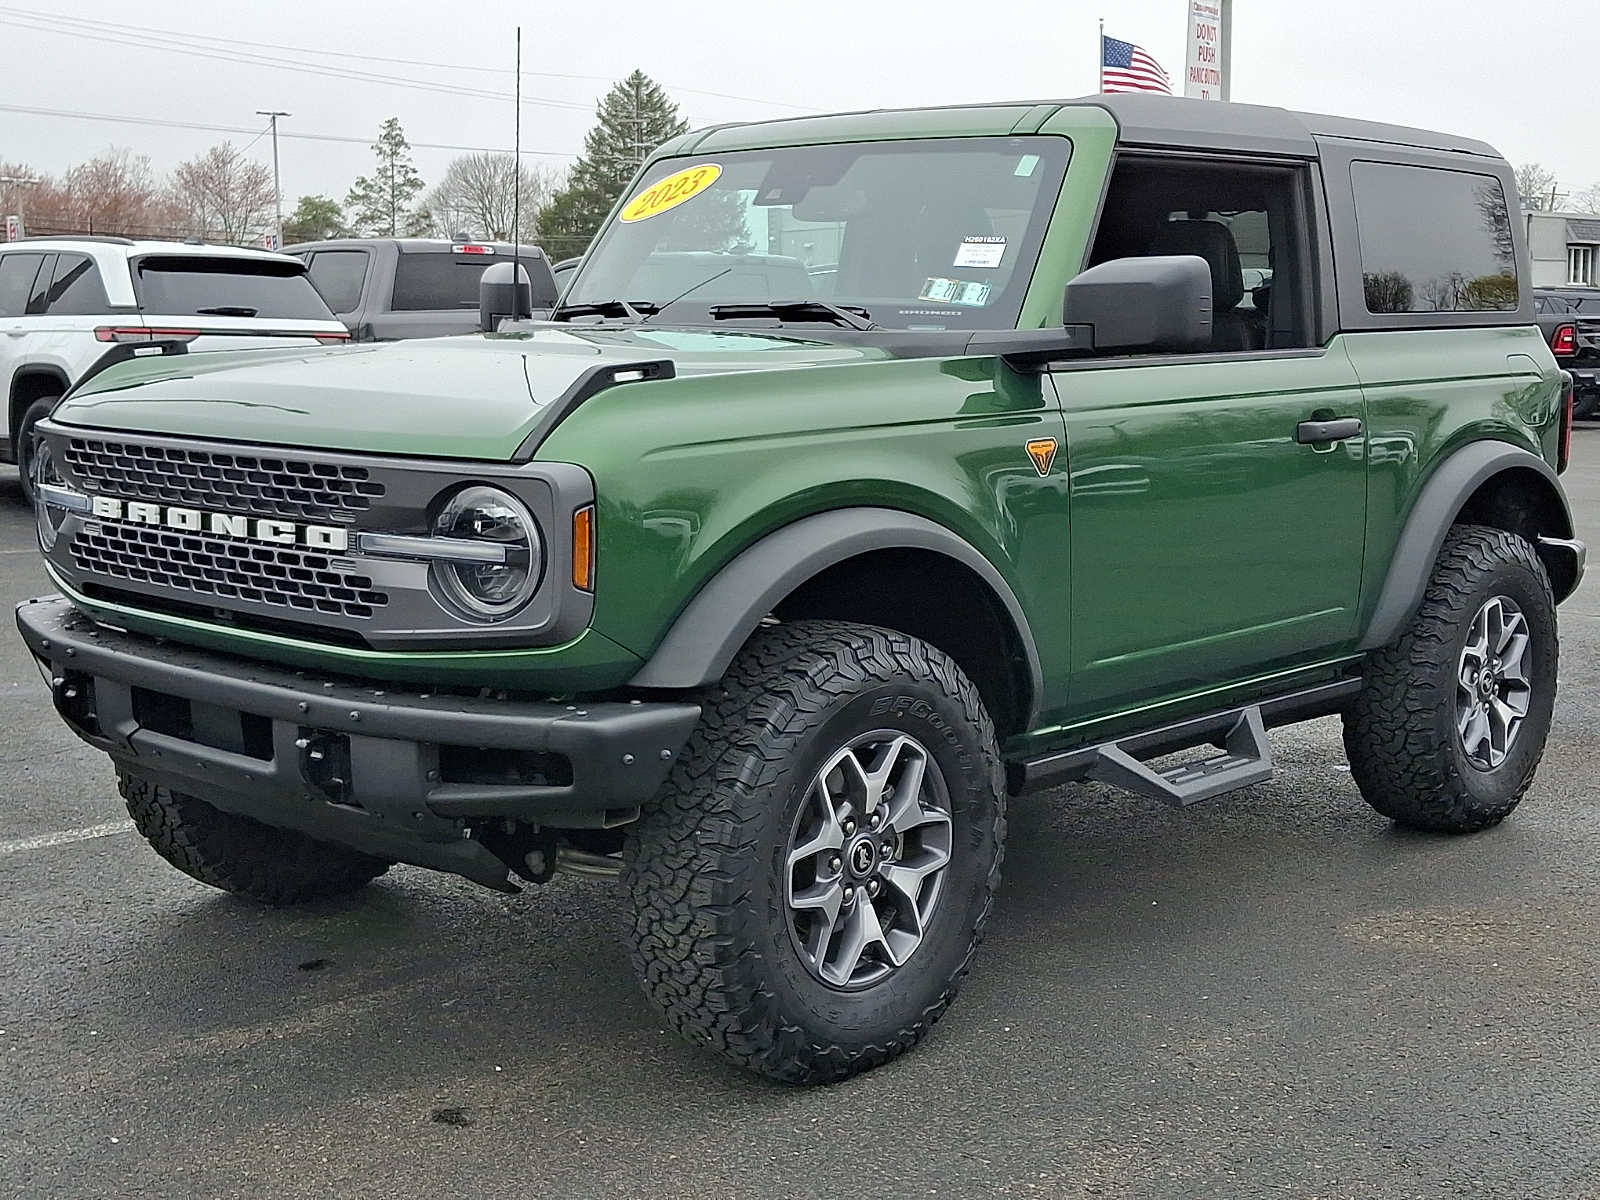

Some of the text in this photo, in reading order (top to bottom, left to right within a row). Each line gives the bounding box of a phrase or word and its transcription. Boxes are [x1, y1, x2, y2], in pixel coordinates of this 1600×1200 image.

[1198, 45, 1216, 63] PUSH
[633, 169, 707, 216] 2023
[92, 495, 349, 551] BRONCO
